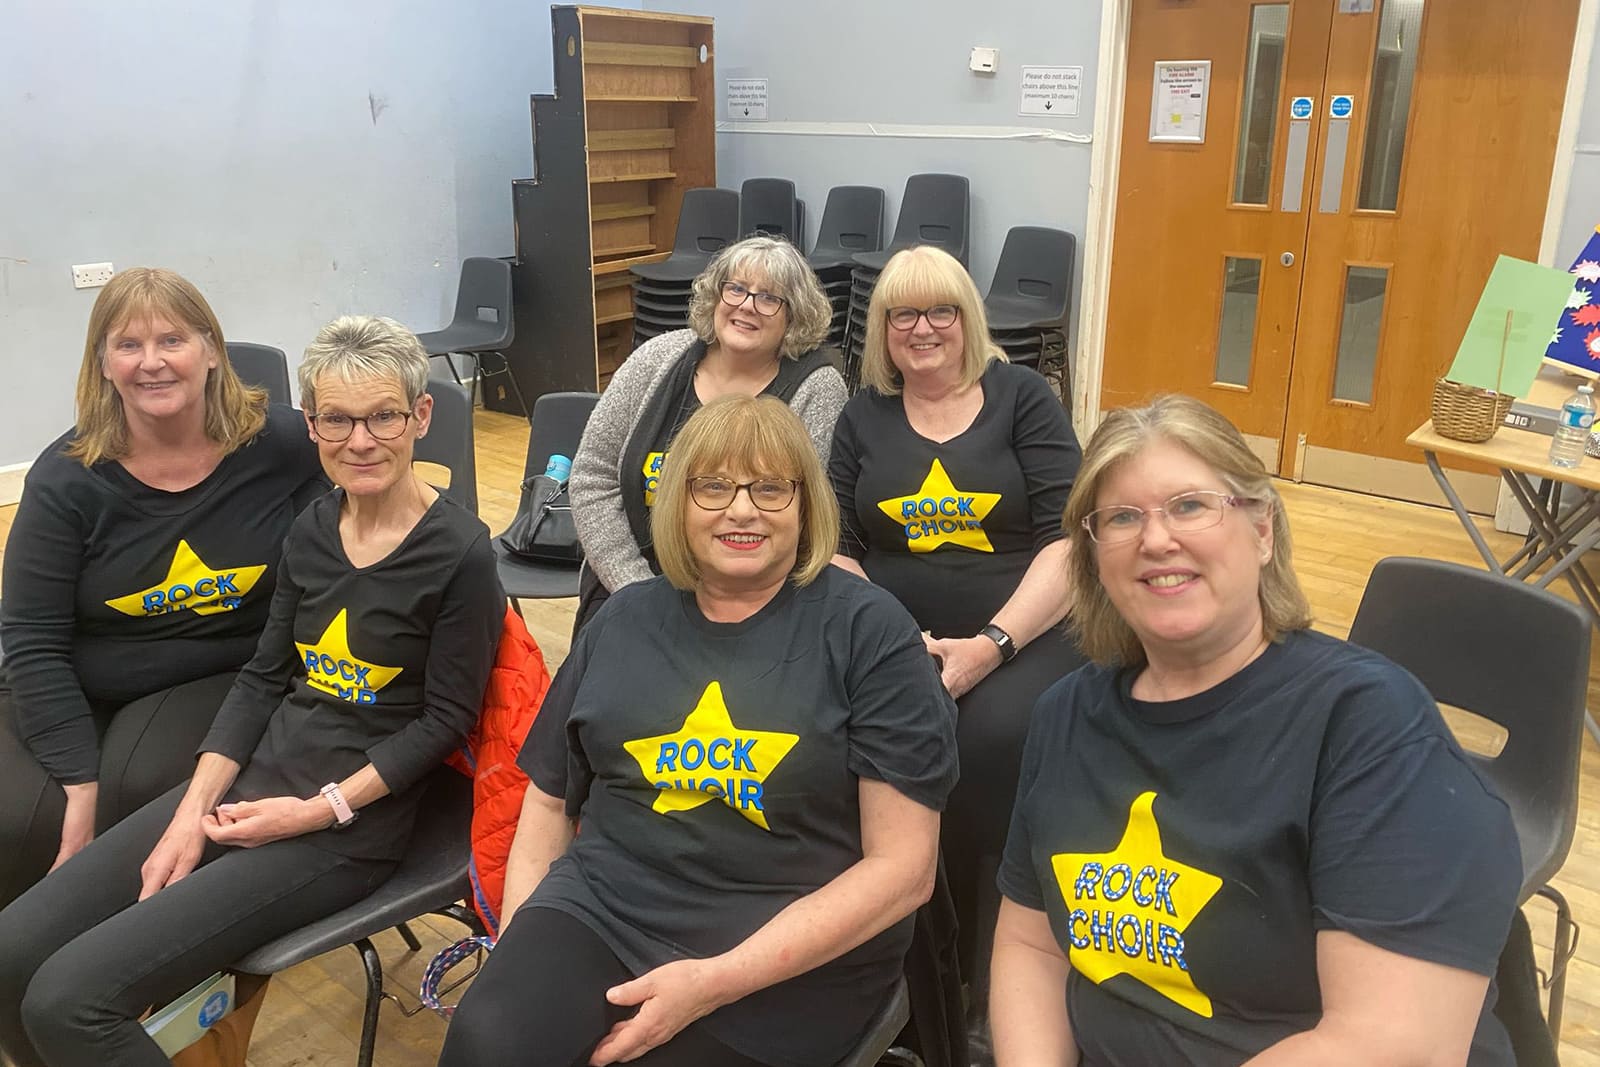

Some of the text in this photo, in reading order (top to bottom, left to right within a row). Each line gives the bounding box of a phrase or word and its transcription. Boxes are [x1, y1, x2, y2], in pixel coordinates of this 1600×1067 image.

[902, 496, 977, 519] ROCK
[143, 573, 240, 613] ROCK
[305, 649, 371, 688] ROCK
[656, 737, 758, 773] ROCK
[1074, 862, 1180, 918] ROCK
[1068, 908, 1188, 970] CHOIR
